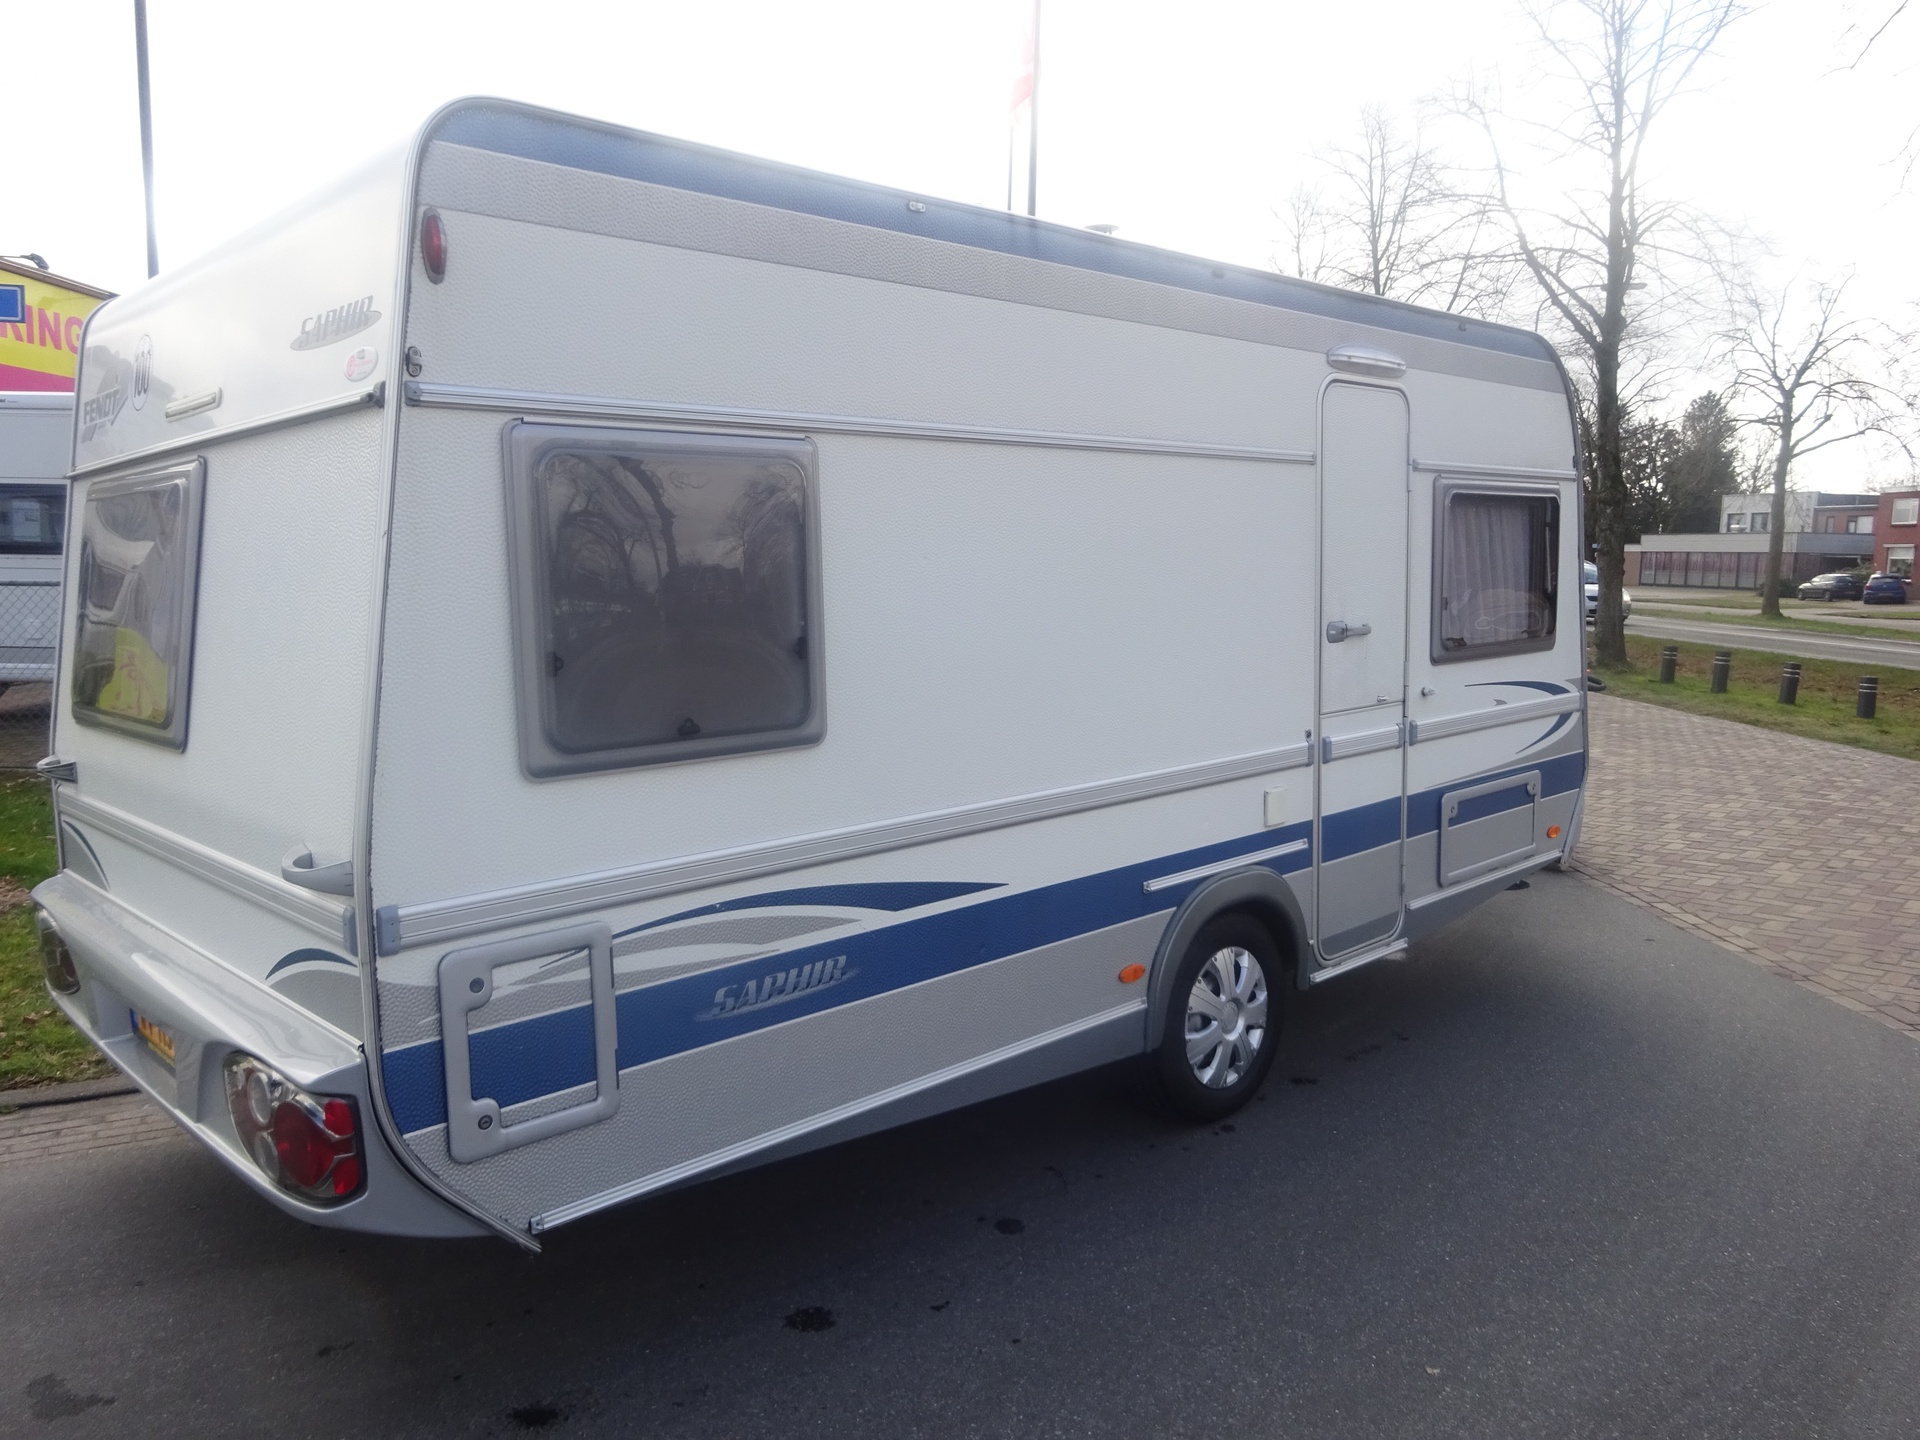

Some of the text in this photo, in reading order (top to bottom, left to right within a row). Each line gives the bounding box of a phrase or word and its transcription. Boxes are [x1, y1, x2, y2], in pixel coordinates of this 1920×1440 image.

[298, 295, 374, 348] SAPHIR
[83, 389, 121, 425] FENDT
[712, 955, 847, 1017] SAPHIR
